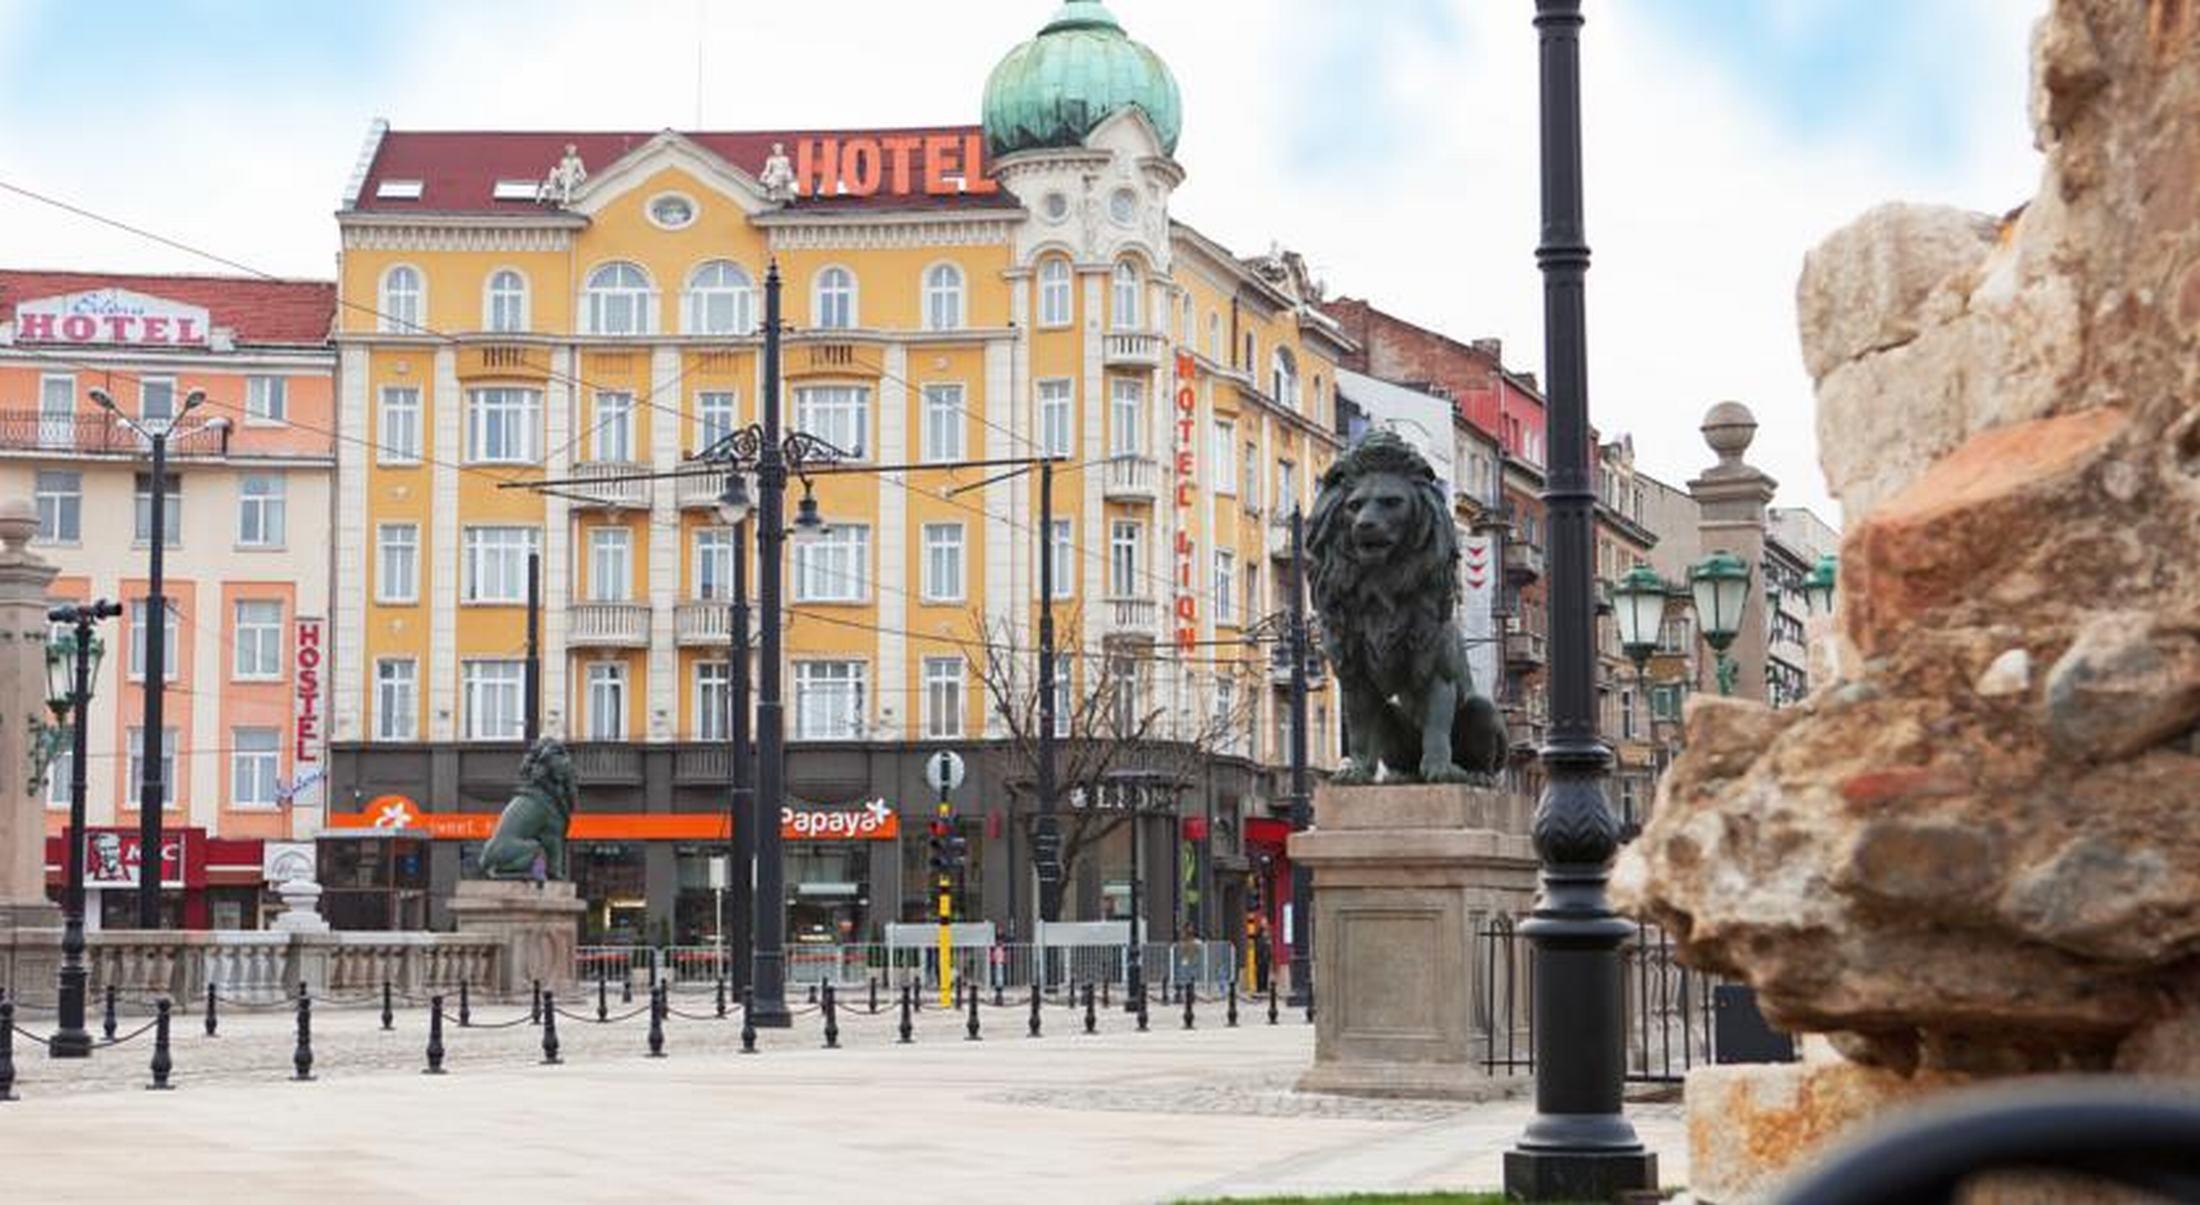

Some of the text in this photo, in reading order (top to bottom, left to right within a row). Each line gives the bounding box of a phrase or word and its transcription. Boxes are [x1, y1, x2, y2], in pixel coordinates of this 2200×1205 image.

[798, 133, 998, 196] HOTEL
[20, 313, 204, 343] HOTEL
[1177, 354, 1195, 508] HOTEL
[297, 623, 320, 762] HOSTEL
[125, 843, 179, 861] KC
